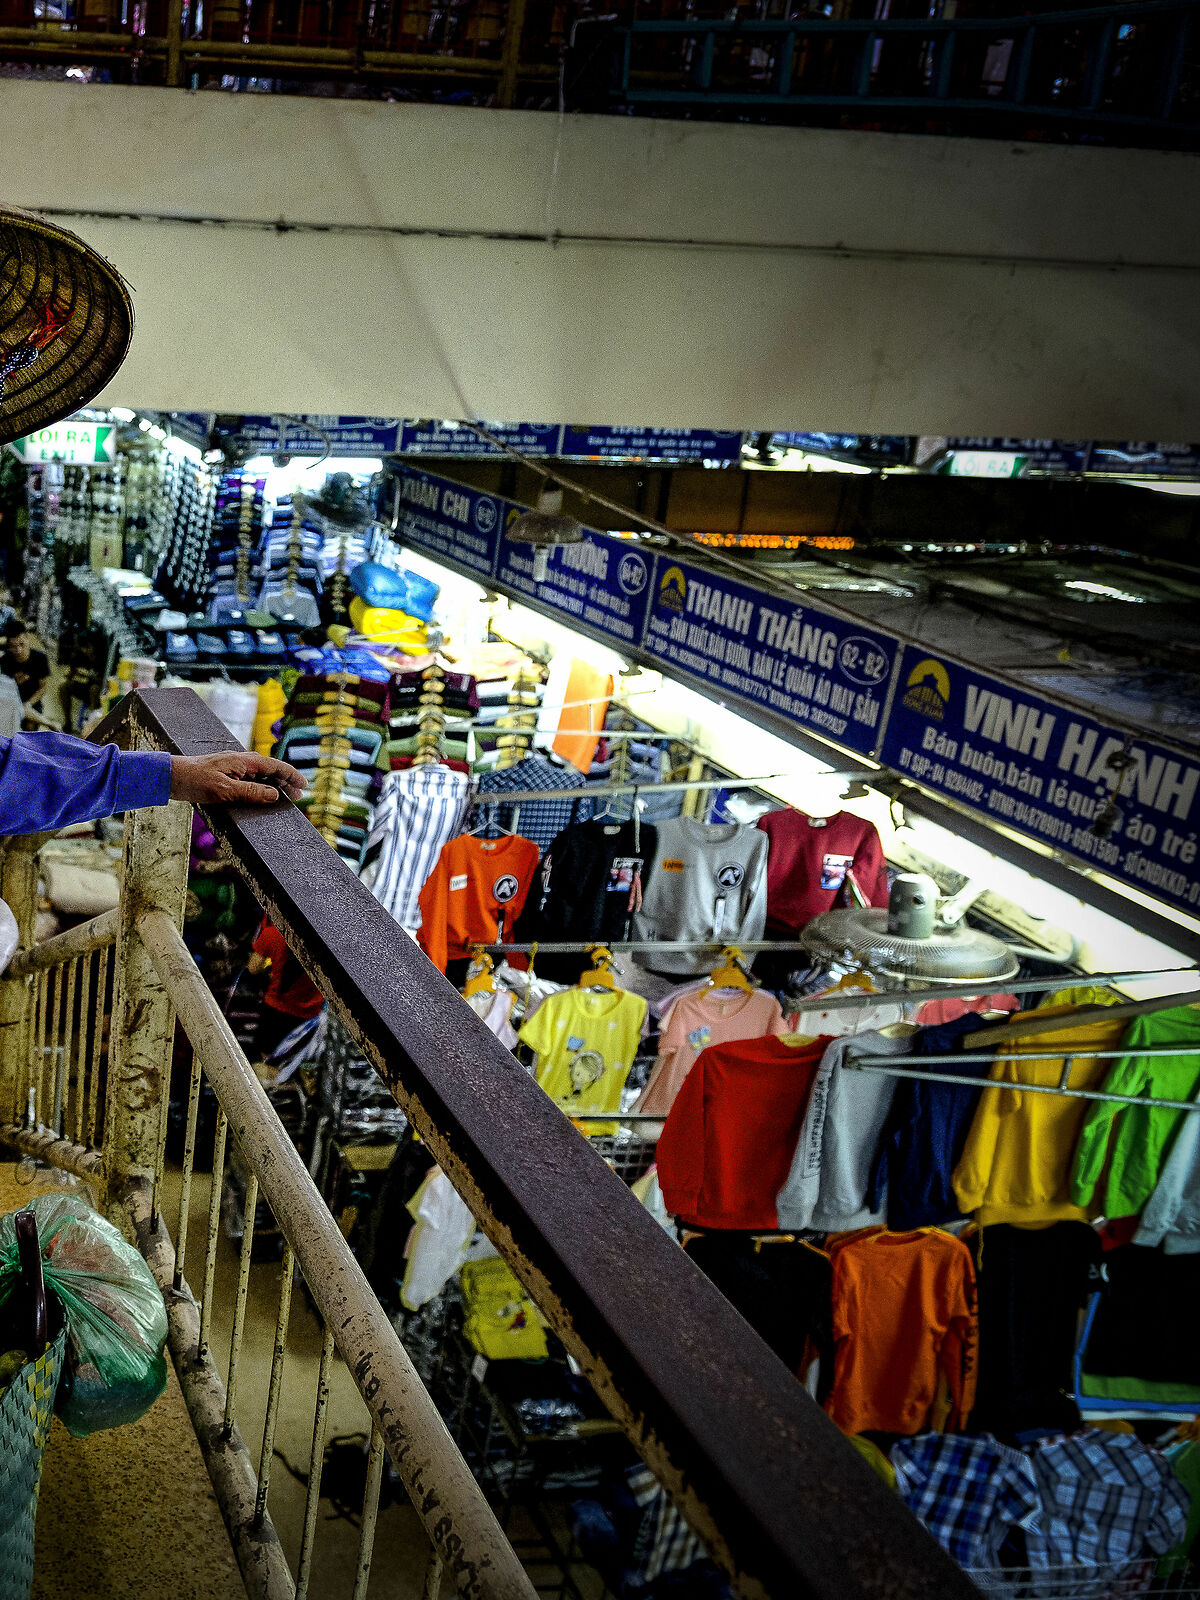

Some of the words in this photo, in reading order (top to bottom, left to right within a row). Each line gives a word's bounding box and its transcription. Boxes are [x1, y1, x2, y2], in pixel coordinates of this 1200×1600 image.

[66, 430, 91, 444] RA
[686, 580, 753, 634] THANH
[757, 607, 840, 670] THẮNG
[923, 726, 958, 760] Bán
[1126, 808, 1157, 847] áo
[1162, 825, 1198, 866] trẻ
[963, 685, 1056, 761] VINH
[1058, 722, 1200, 820] HẠNH
